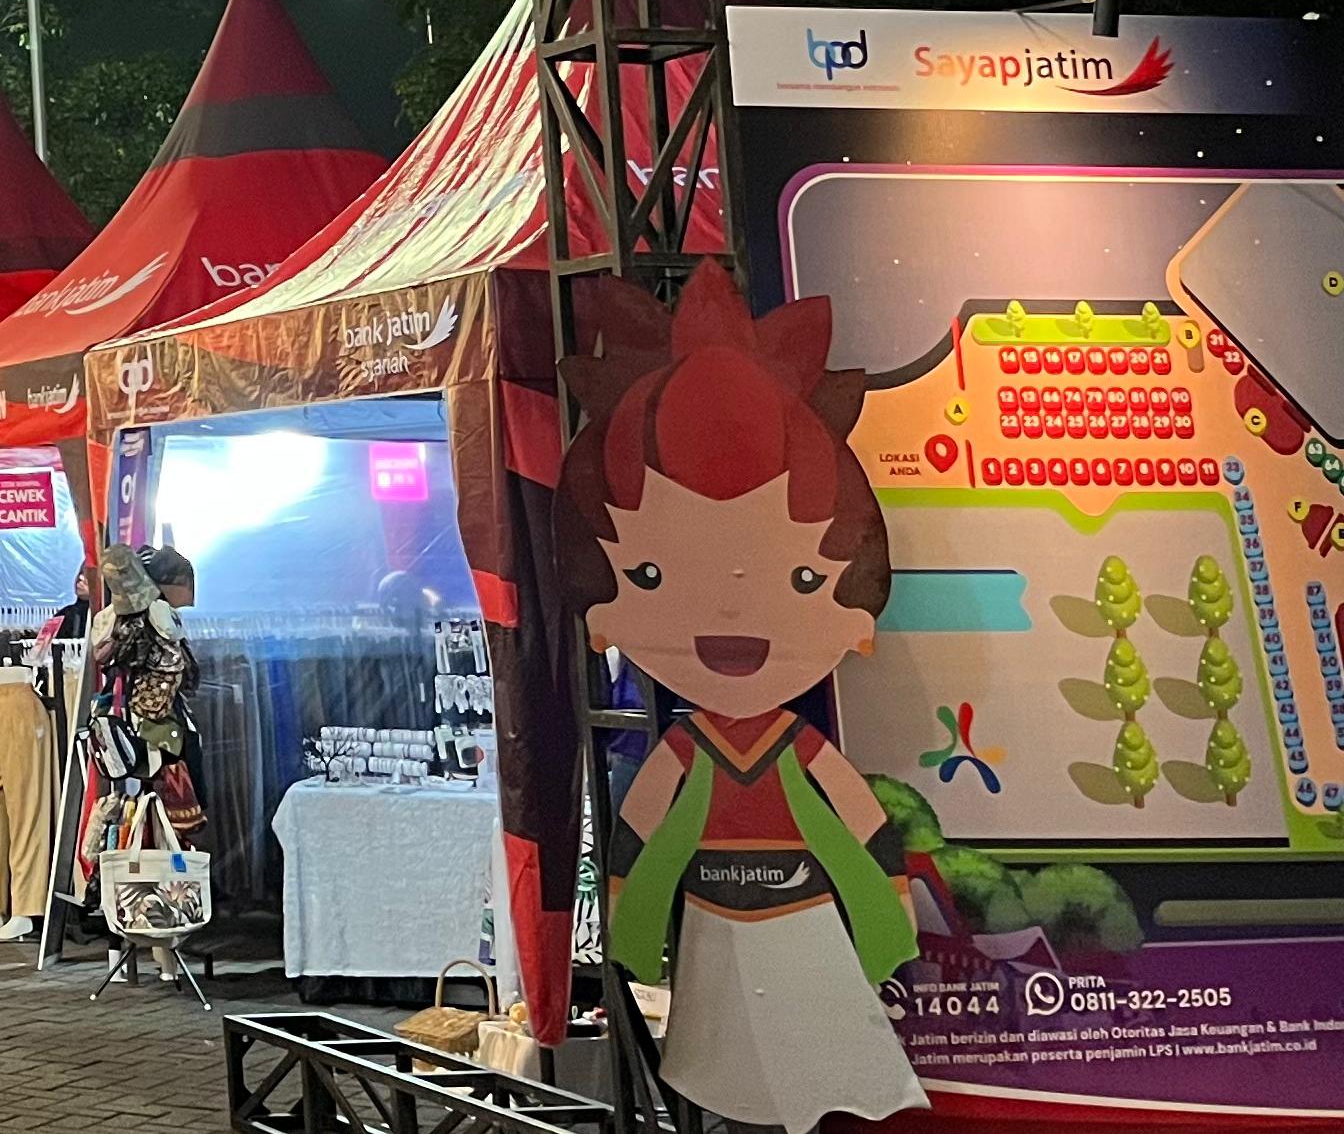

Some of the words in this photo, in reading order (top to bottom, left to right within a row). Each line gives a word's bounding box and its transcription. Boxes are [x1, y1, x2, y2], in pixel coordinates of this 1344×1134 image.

[913, 44, 1114, 88] Sayapjatim
[1328, 277, 1338, 288] D
[1185, 330, 1194, 340] B
[954, 404, 963, 414] A
[1251, 415, 1261, 426] C
[1008, 463, 1018, 475] 2
[1030, 463, 1039, 475] 3
[1052, 463, 1062, 475] 4
[1074, 463, 1084, 475] 5
[1118, 463, 1127, 475] 7
[1161, 463, 1170, 475] 9
[1179, 463, 1194, 475] 10
[1201, 463, 1215, 475] 11
[1294, 502, 1302, 513] F
[699, 864, 785, 886] bankjatim
[969, 981, 1000, 993] JATIM
[1068, 975, 1107, 990] PRITA
[914, 995, 1000, 1017] 14044
[1069, 987, 1232, 1012] 0811-322-2505
[950, 1031, 997, 1046] berizin
[999, 1030, 1026, 1044] dan
[1027, 1028, 1078, 1043] diawasi
[1080, 1027, 1109, 1042] oleh
[1111, 1025, 1166, 1040] Otoritas
[1200, 1021, 1265, 1038] Keuangan
[1266, 1020, 1277, 1033] &
[952, 1050, 1029, 1067] merupakan
[1031, 1048, 1084, 1064] peserta
[1085, 1045, 1147, 1064] penjamin
[1148, 1042, 1174, 1057] LPS
